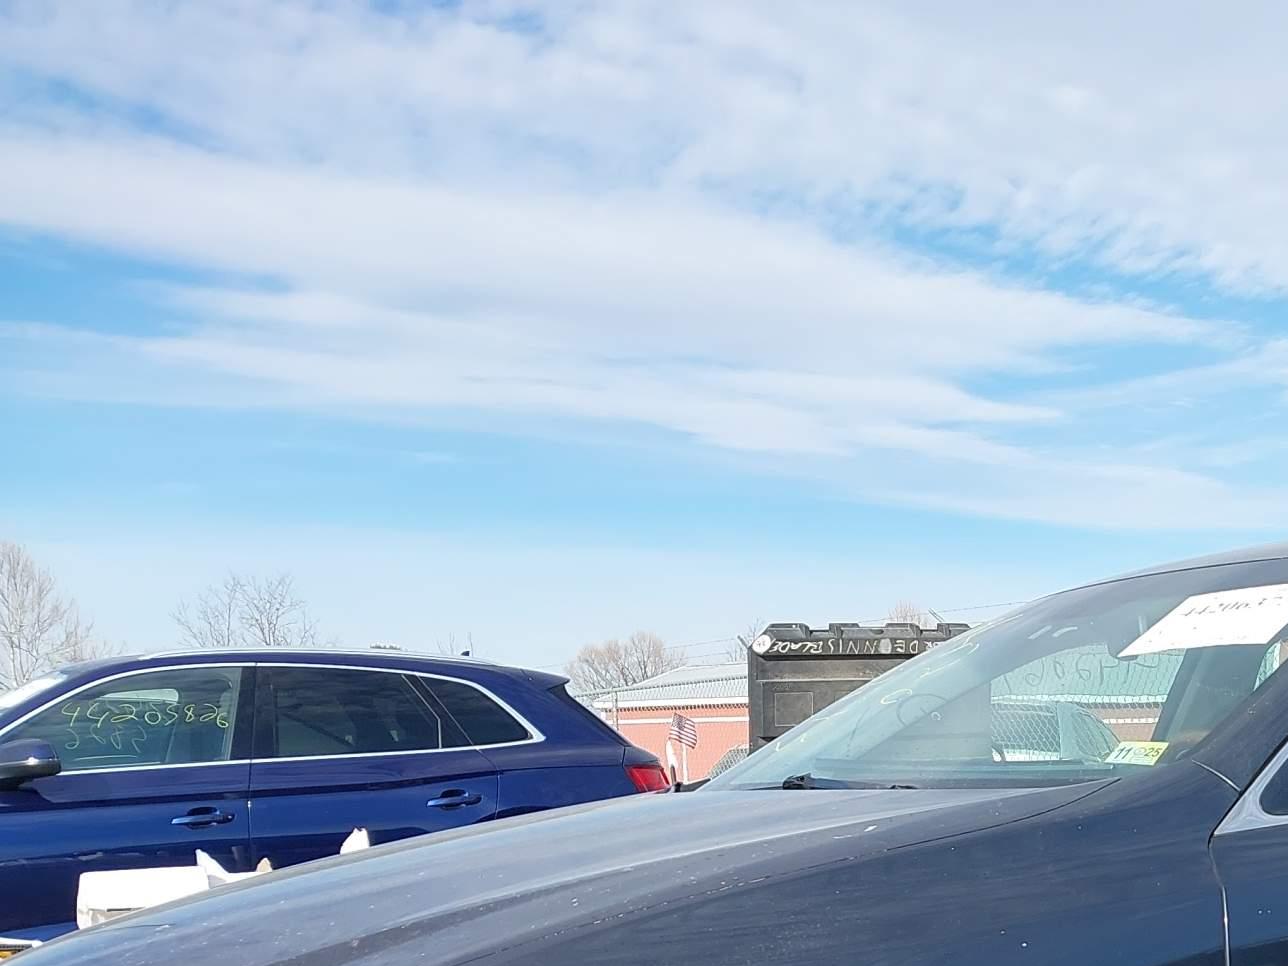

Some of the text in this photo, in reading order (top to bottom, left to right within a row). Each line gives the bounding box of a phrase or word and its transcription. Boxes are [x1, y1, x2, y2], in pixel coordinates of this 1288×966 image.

[768, 639, 823, 654] BLADE
[61, 701, 229, 729] 44205826
[1143, 746, 1163, 758] 25
